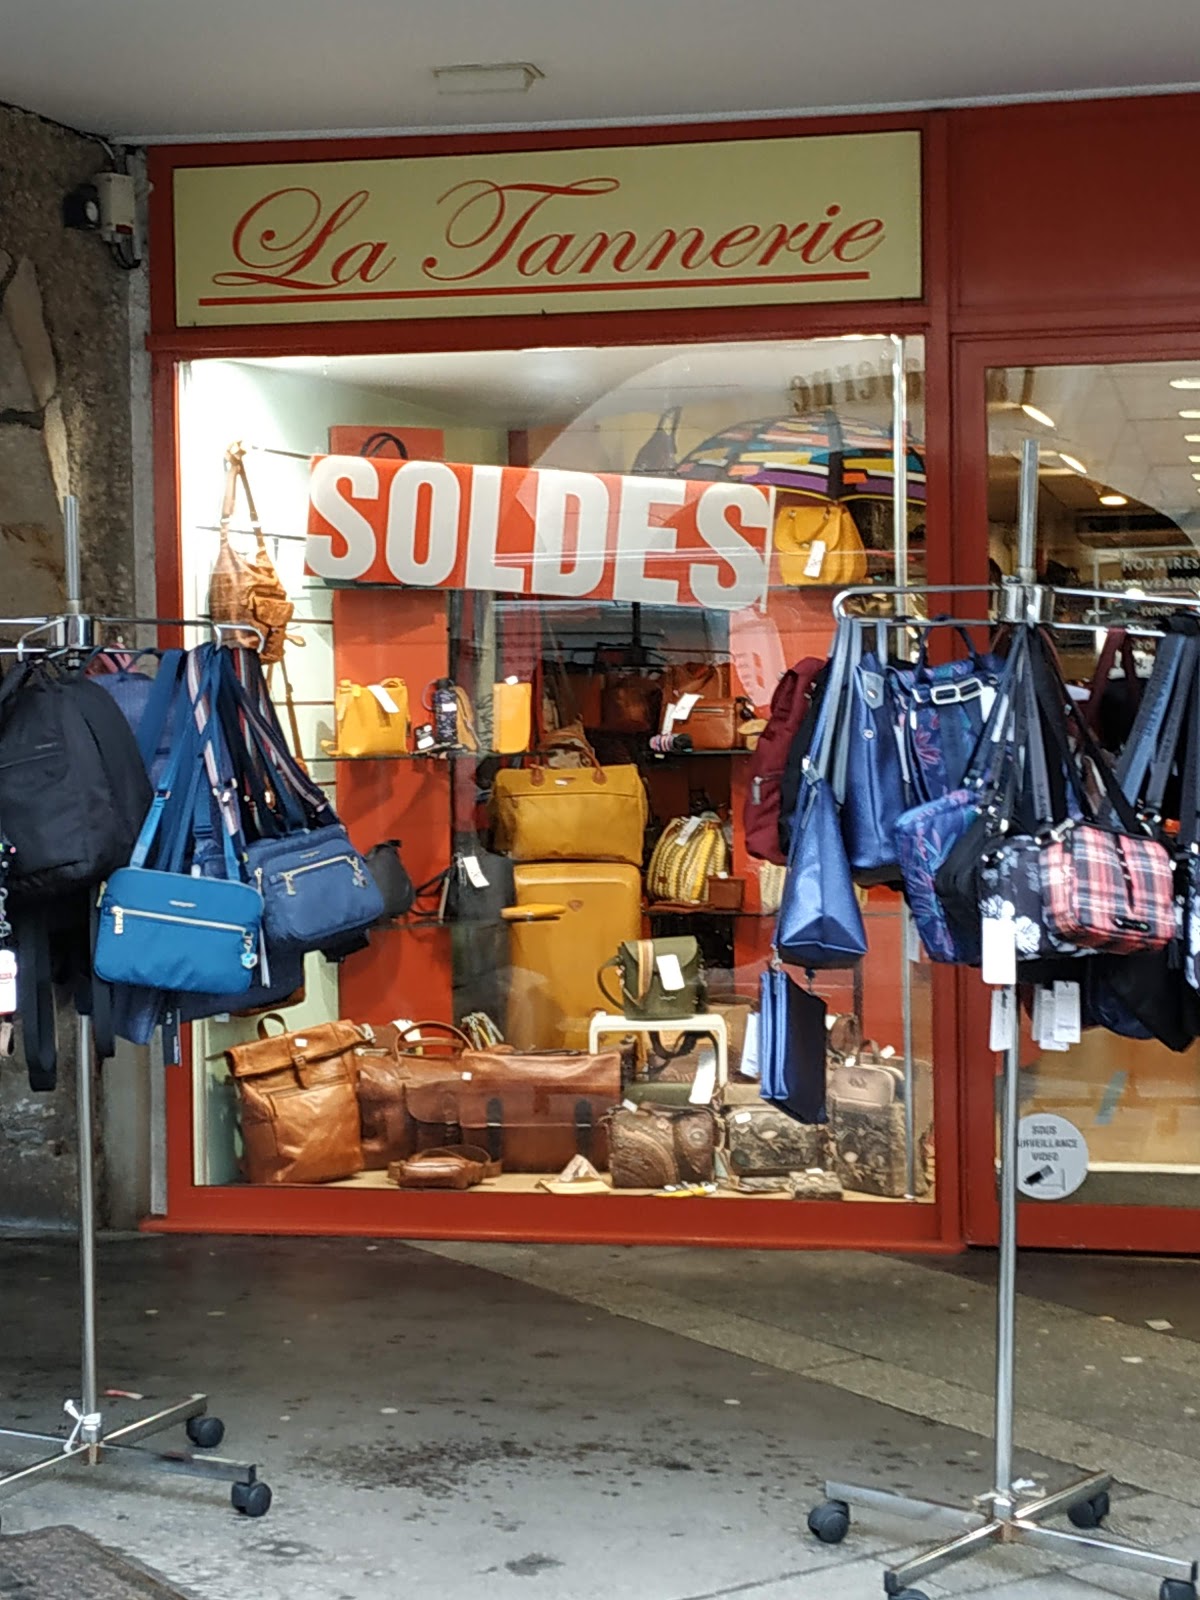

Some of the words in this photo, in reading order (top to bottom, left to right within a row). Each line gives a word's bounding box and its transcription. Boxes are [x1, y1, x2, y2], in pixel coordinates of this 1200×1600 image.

[212, 187, 395, 290] La
[422, 177, 884, 281] Tannerie
[304, 456, 769, 611] SOLDES
[1121, 556, 1200, 571] HORAIRES
[1018, 1139, 1078, 1149] URVEILLANCE
